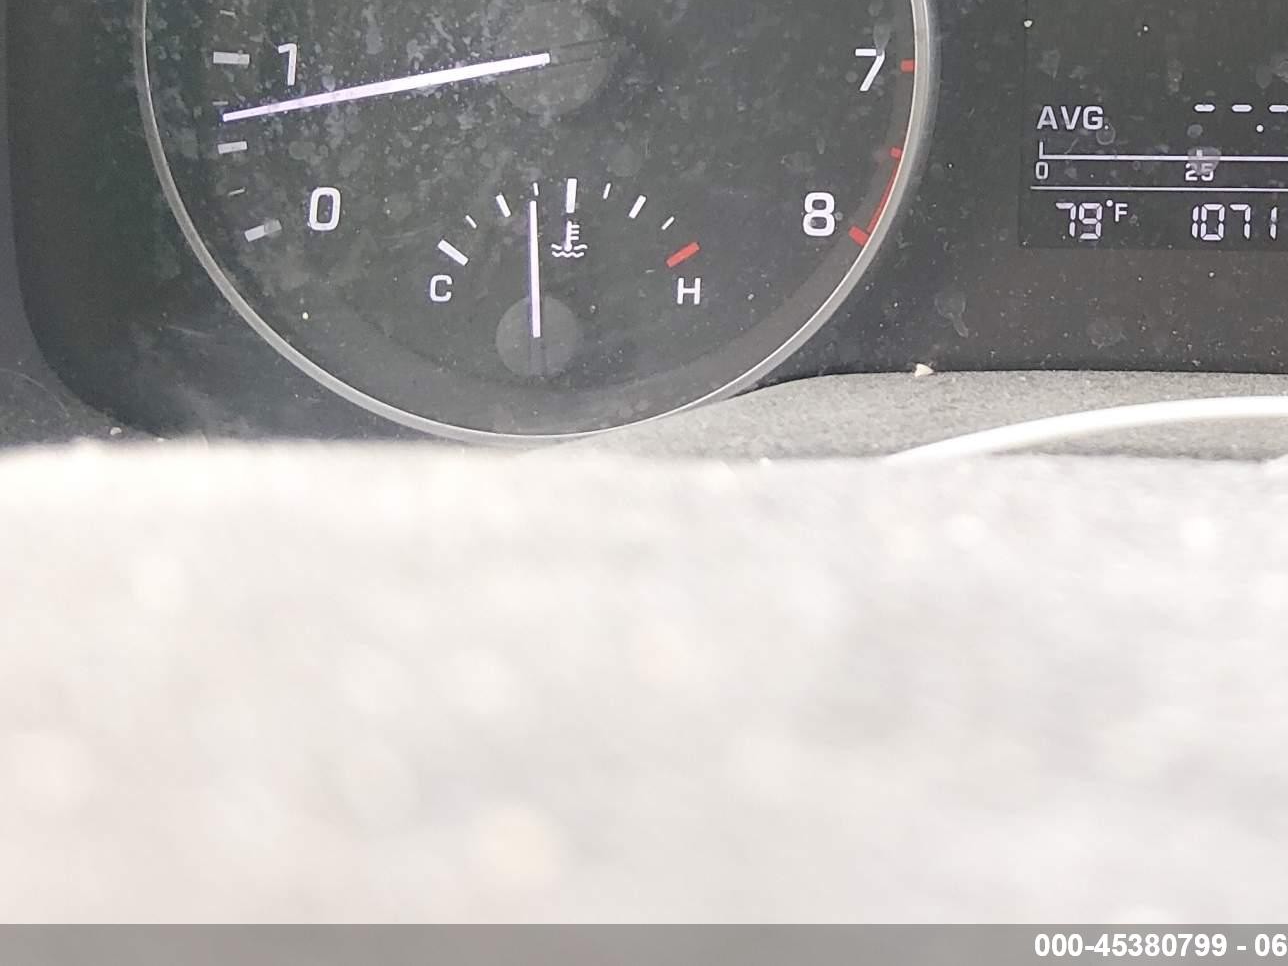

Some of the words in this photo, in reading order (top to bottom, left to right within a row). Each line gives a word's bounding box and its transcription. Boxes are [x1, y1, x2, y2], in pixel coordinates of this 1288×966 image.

[278, 43, 296, 85] 1
[854, 48, 884, 91] 7
[1035, 162, 1049, 180] 0
[309, 187, 341, 230] 0
[803, 193, 835, 235] 8
[430, 275, 453, 302] C
[676, 278, 702, 305] H
